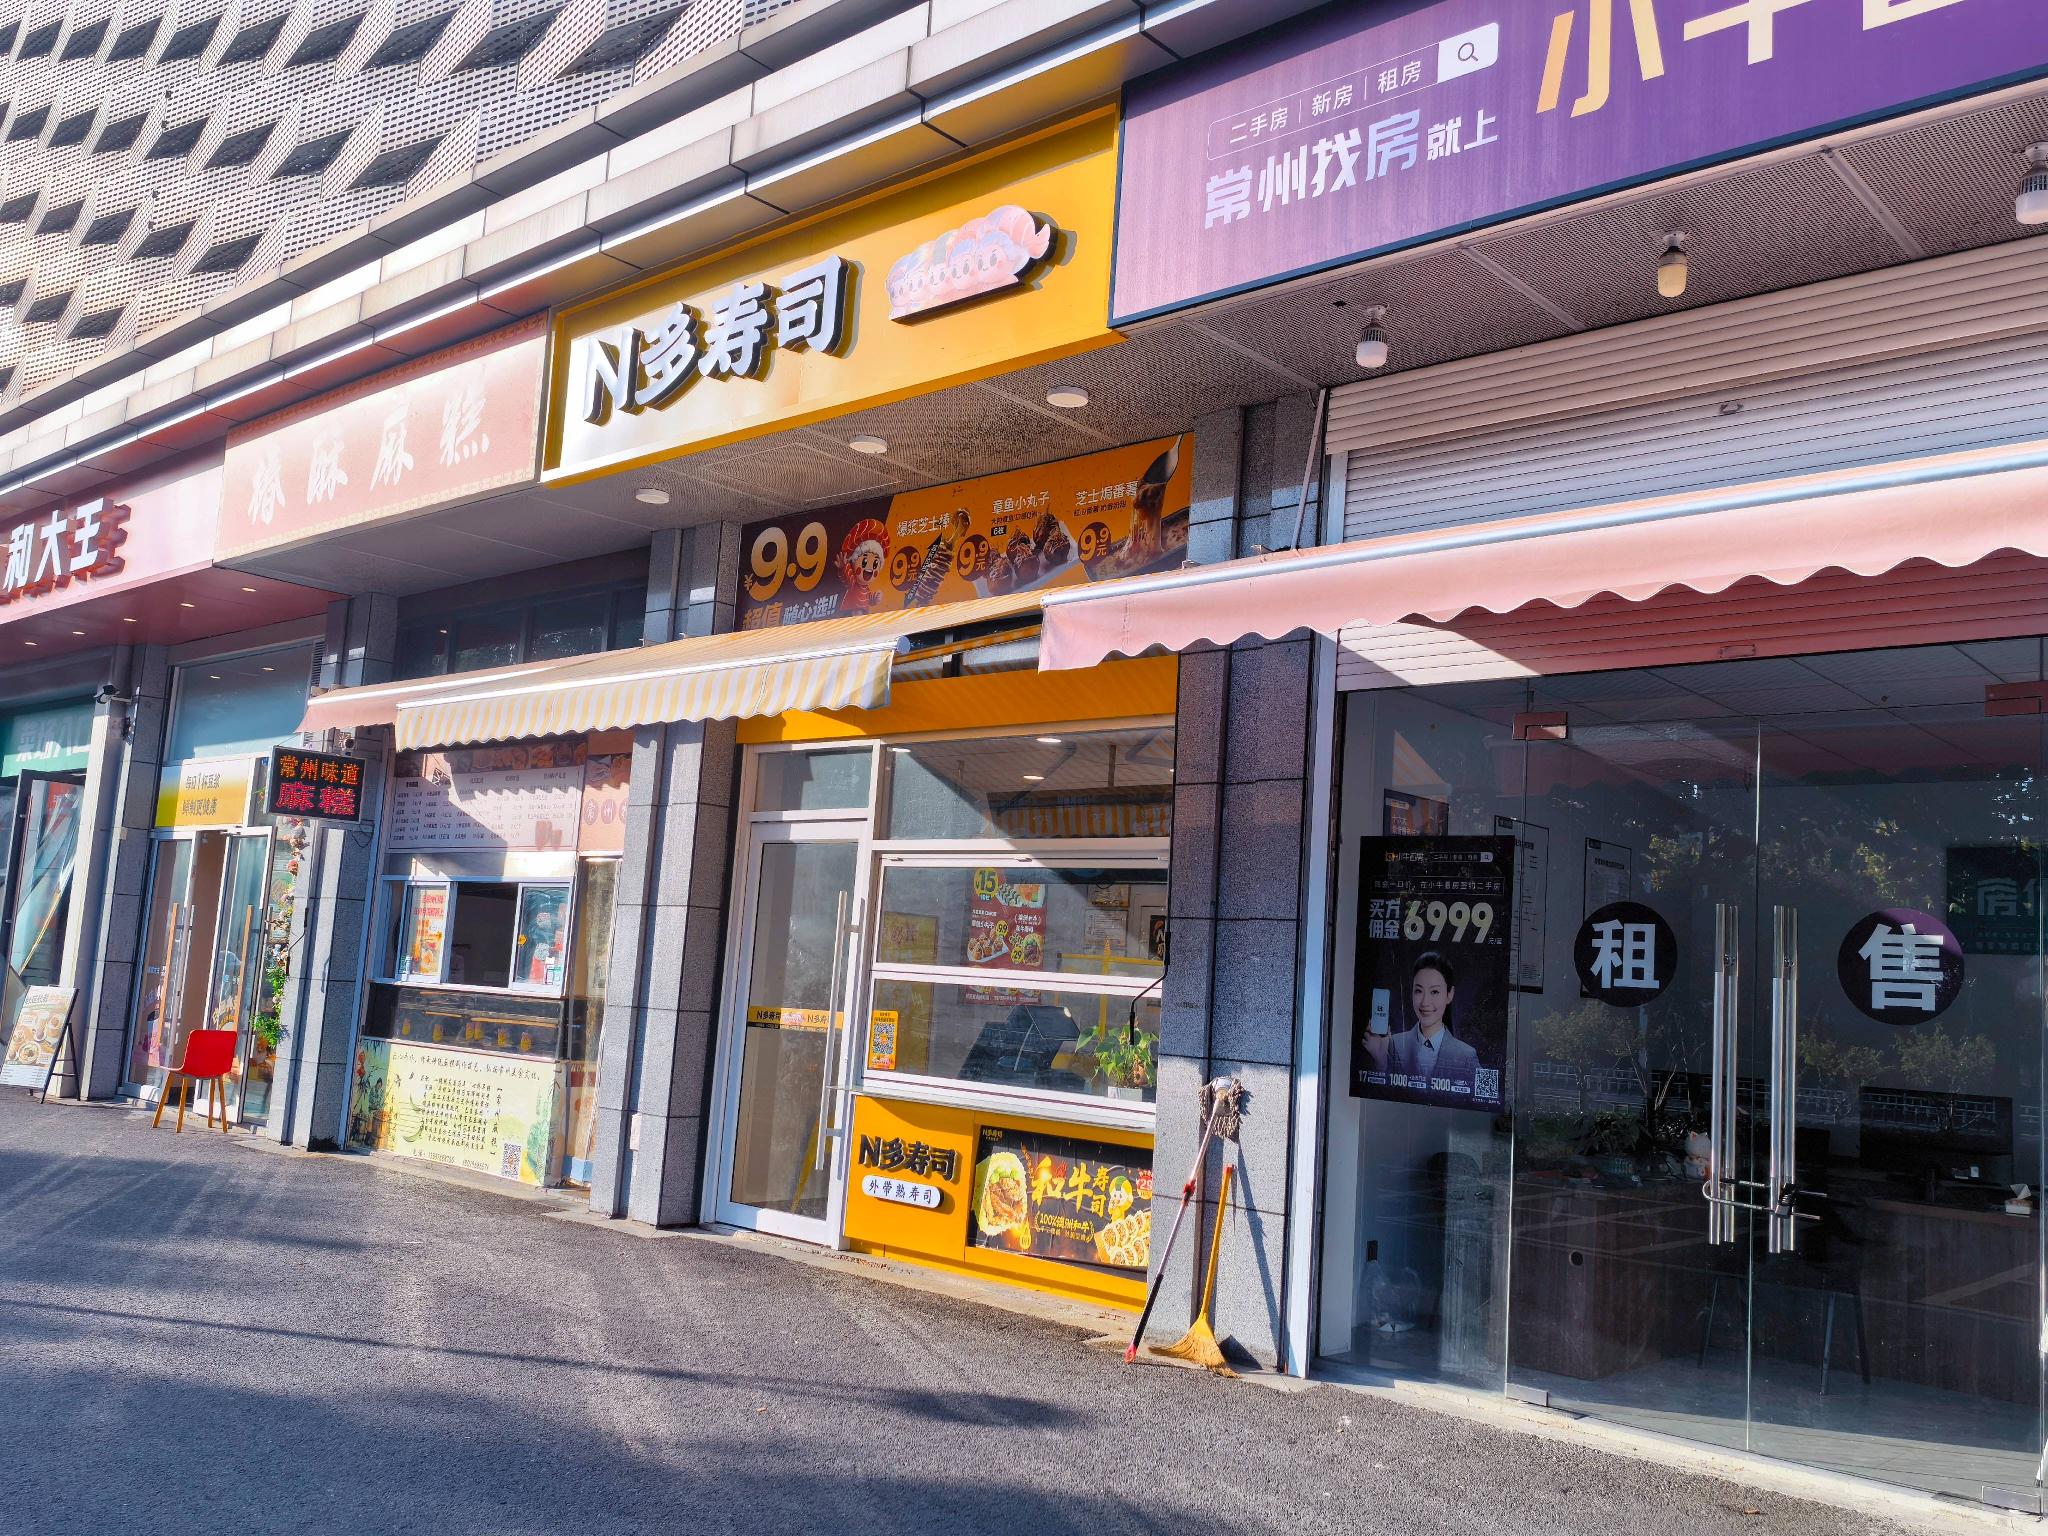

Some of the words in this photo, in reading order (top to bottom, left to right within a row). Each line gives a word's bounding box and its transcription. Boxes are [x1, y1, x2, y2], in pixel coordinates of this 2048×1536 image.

[1230, 107, 1289, 144] 二手房
[1312, 84, 1353, 116] 新房
[1378, 58, 1422, 93] 租房
[584, 256, 847, 423] N多寿司
[991, 491, 1050, 514] 章鱼小丸子
[1075, 480, 1138, 506] 芝士焗番薯
[896, 513, 950, 537] 爆浆芝士棒
[3, 497, 104, 592] 和大王
[280, 755, 360, 785] 常州味道
[276, 781, 356, 816] 麻糕
[1369, 897, 1401, 919] 买方
[1404, 900, 1494, 944] 6999
[1368, 919, 1400, 939] 佣金
[1589, 918, 1660, 990] 租
[1858, 923, 1944, 1011] 售
[1359, 1070, 1368, 1083] 17
[1389, 1073, 1408, 1087] 1000
[1430, 1077, 1450, 1092] 5000
[859, 1134, 957, 1182] N多寿司
[1031, 1155, 1094, 1214] 和牛
[1091, 1165, 1110, 1218] 寿司
